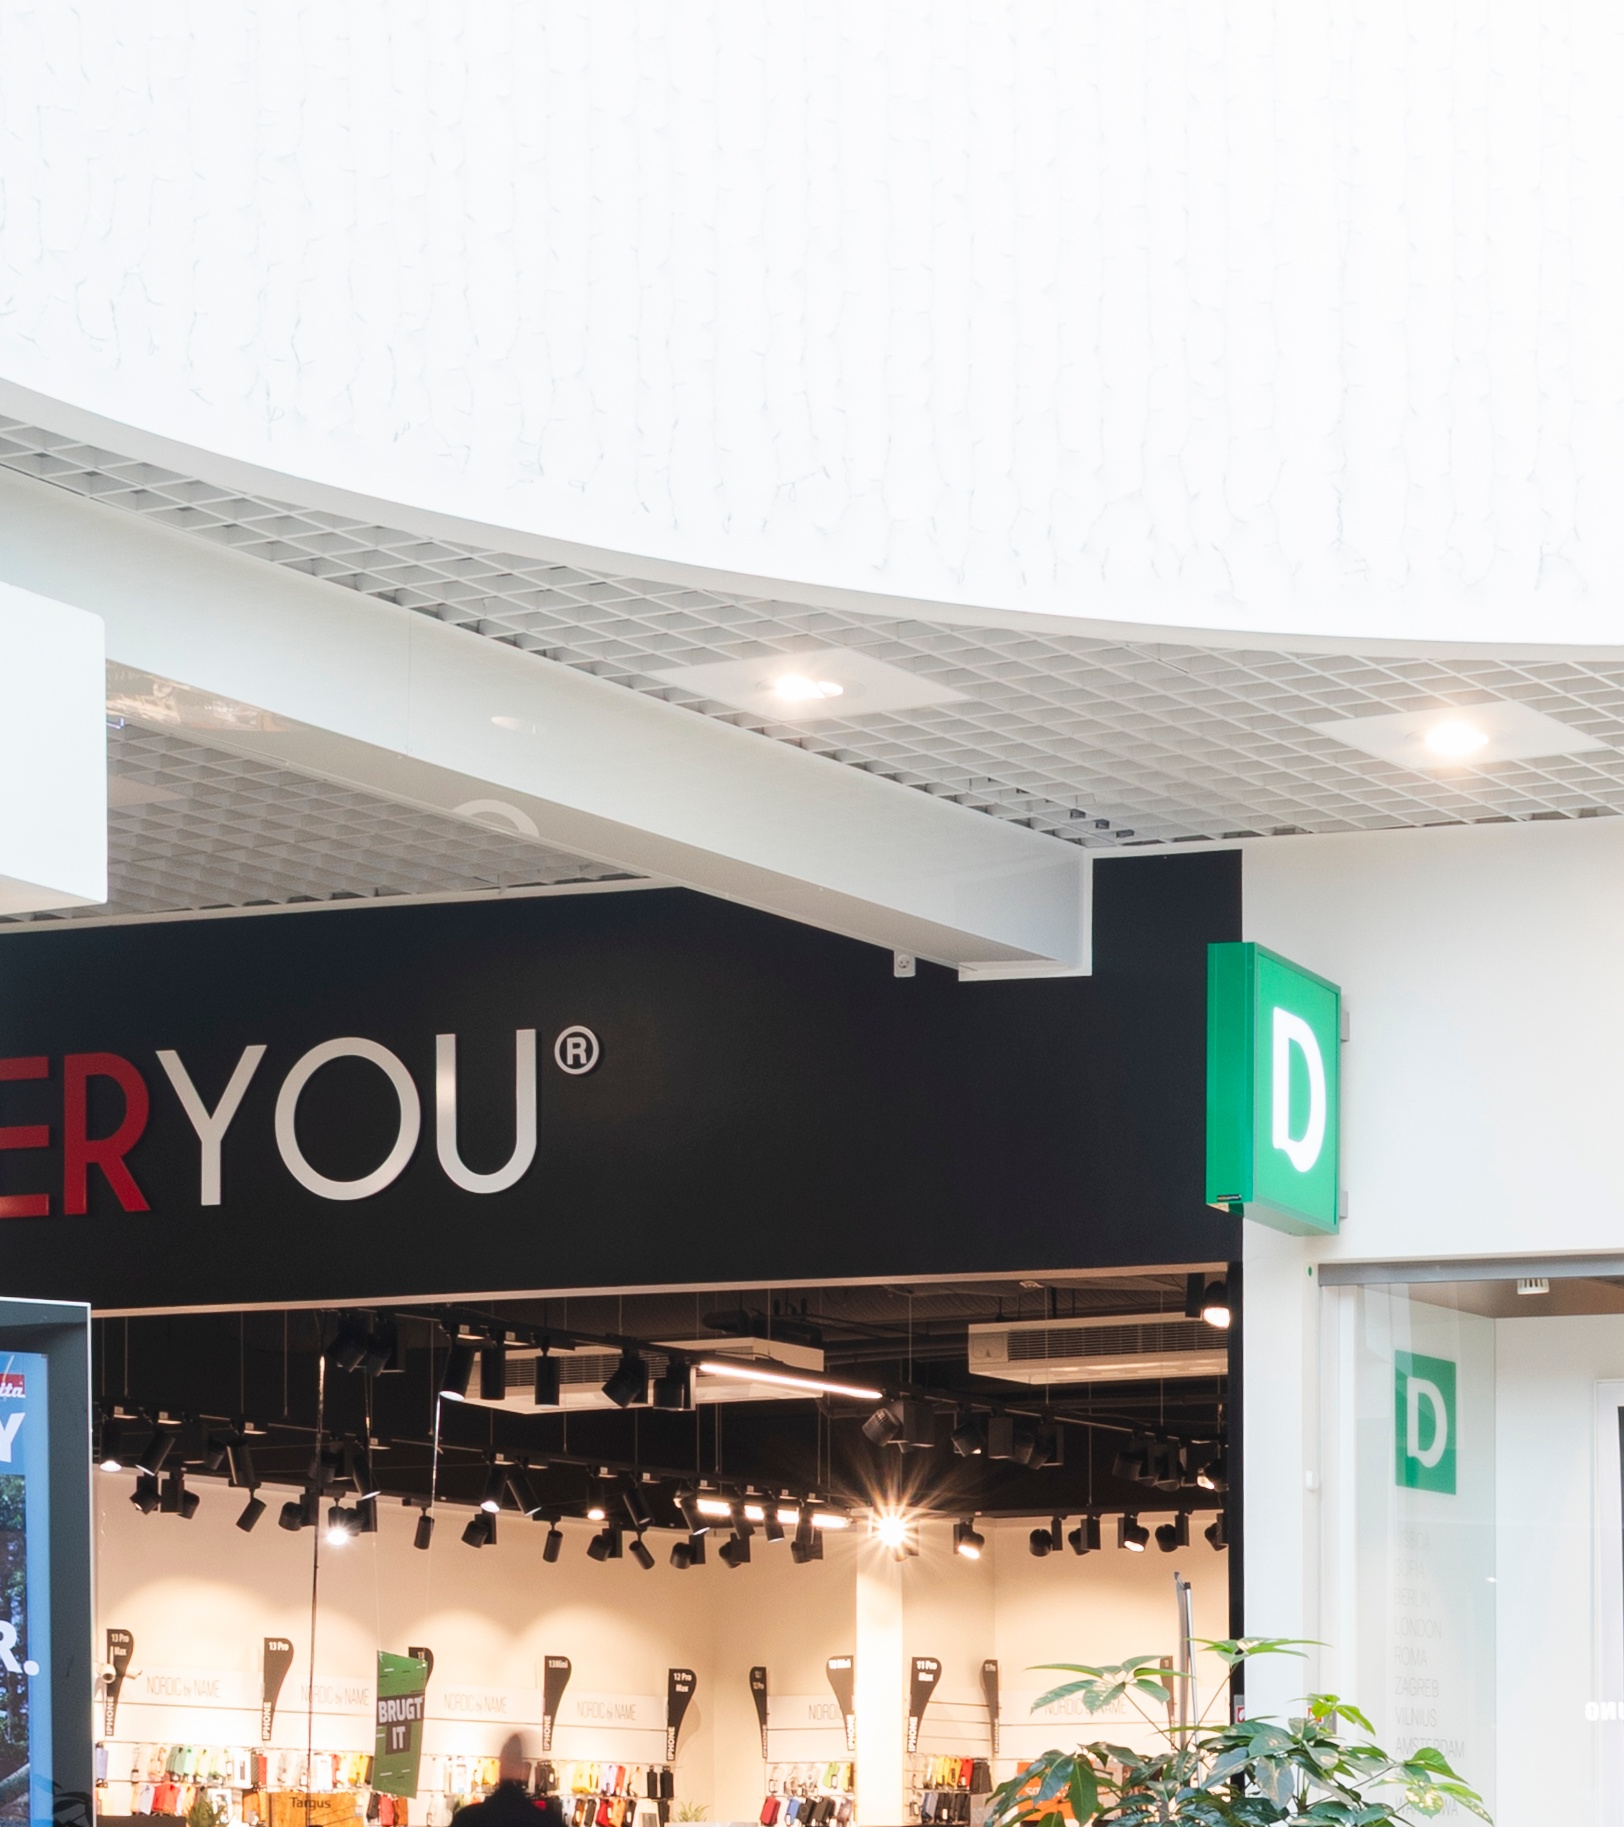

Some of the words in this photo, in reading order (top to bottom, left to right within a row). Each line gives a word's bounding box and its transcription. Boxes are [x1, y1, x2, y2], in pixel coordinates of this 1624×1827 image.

[1272, 1007, 1326, 1173] D
[1395, 1617, 1442, 1639] LONDON
[1394, 1647, 1427, 1667] ROMA
[147, 1676, 183, 1697] NORDIC
[194, 1680, 220, 1698] NAME
[301, 1686, 333, 1705] NORDIC
[344, 1688, 370, 1706] NAME
[1394, 1676, 1439, 1697] ZAGREB
[378, 1696, 424, 1724] BRUGT
[444, 1693, 475, 1712] NORDIC
[484, 1696, 507, 1713] NAME
[614, 1703, 636, 1720] NAME
[106, 1697, 114, 1735] IPHONE
[263, 1701, 272, 1740] IPHONE
[1394, 1707, 1437, 1728] VILNIUS
[393, 1726, 406, 1749] IT
[543, 1715, 551, 1750] IPHONE
[908, 1717, 918, 1752] IPHONE
[667, 1727, 675, 1761] IPHONE
[290, 1796, 331, 1810] Targus
